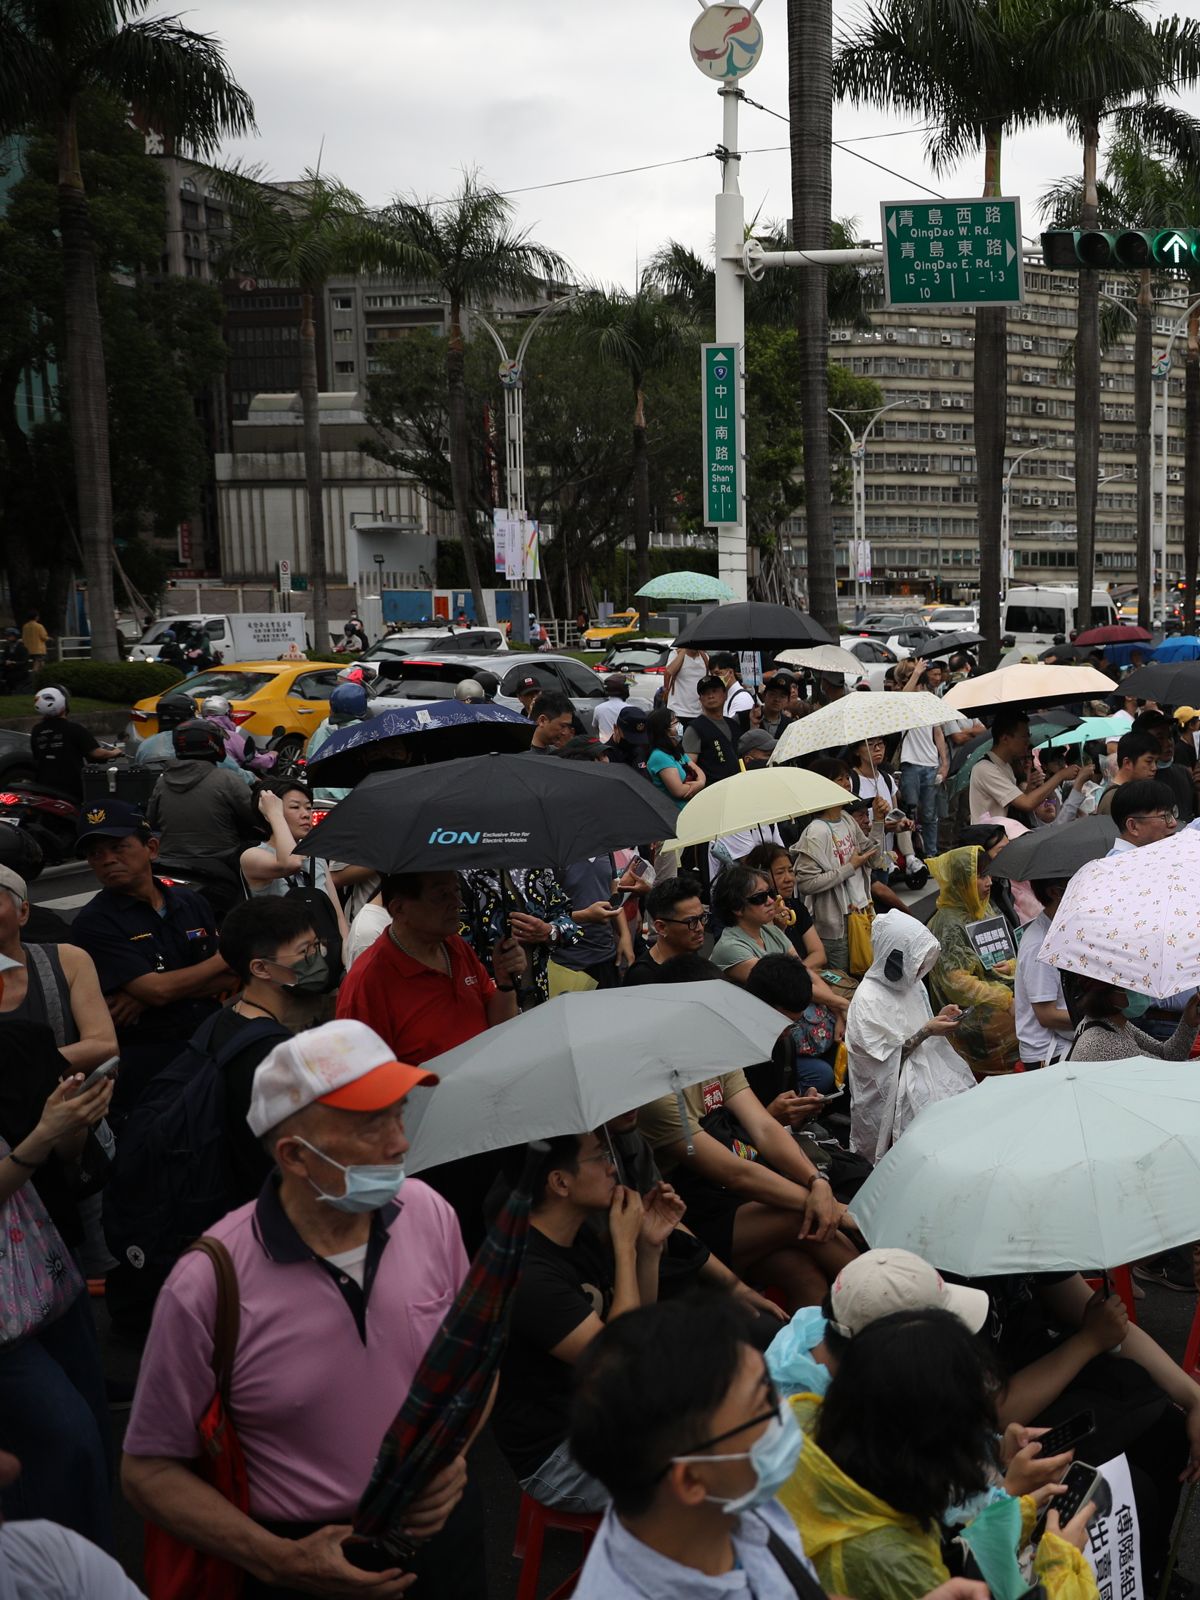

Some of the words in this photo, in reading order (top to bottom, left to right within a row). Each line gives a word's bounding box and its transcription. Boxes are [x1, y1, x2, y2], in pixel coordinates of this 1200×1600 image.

[898, 206, 1001, 227] 青島西路
[910, 227, 954, 239] QingDao
[958, 226, 971, 236] W.
[974, 226, 992, 236] Rd.
[900, 239, 1003, 259] 青島東路
[914, 260, 958, 272] QingDao
[961, 260, 973, 269] E.
[975, 259, 993, 269] Rd.
[905, 273, 915, 285] 15
[934, 273, 940, 284] 3
[919, 287, 931, 298] 10
[714, 384, 729, 461] 中山南路
[711, 463, 734, 474] Zhong
[711, 474, 730, 482] Shan
[712, 485, 719, 493] S.
[720, 485, 733, 493] Rd.
[1115, 1503, 1136, 1600] 傅隨組
